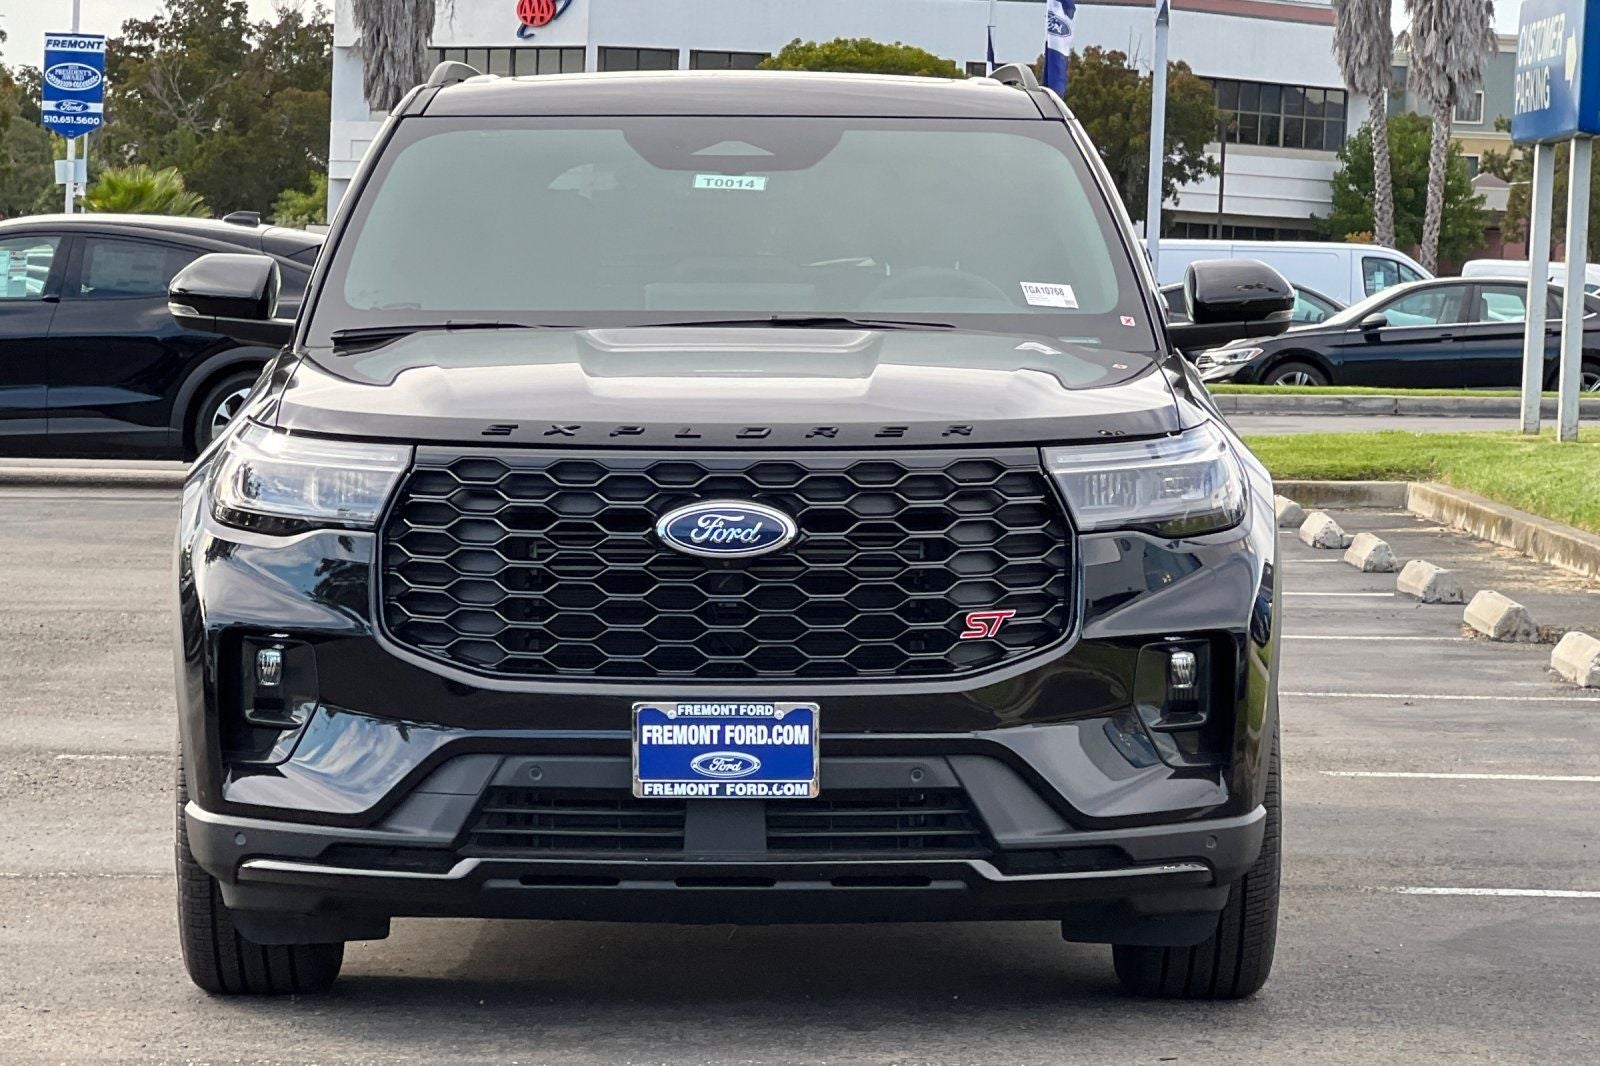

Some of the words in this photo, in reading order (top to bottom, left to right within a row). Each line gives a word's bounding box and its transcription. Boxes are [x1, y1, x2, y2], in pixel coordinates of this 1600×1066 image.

[46, 39, 103, 50] FREMONT
[1518, 12, 1565, 67] CUSTOMER
[1514, 65, 1550, 115] PARKING
[60, 101, 83, 111] Ford
[43, 115, 100, 124] 510.651.5600
[703, 178, 755, 188] T0014
[481, 423, 973, 439] EXPLORER
[690, 513, 763, 543] Ford
[960, 609, 1016, 639] ST
[677, 704, 736, 716] FREMONT
[739, 704, 774, 716] FORD
[642, 724, 720, 745] FREMONT
[724, 724, 809, 745] FORD.COM
[709, 757, 742, 772] Ford
[643, 783, 719, 796] FREMONT
[725, 783, 808, 796] FORD.COM
